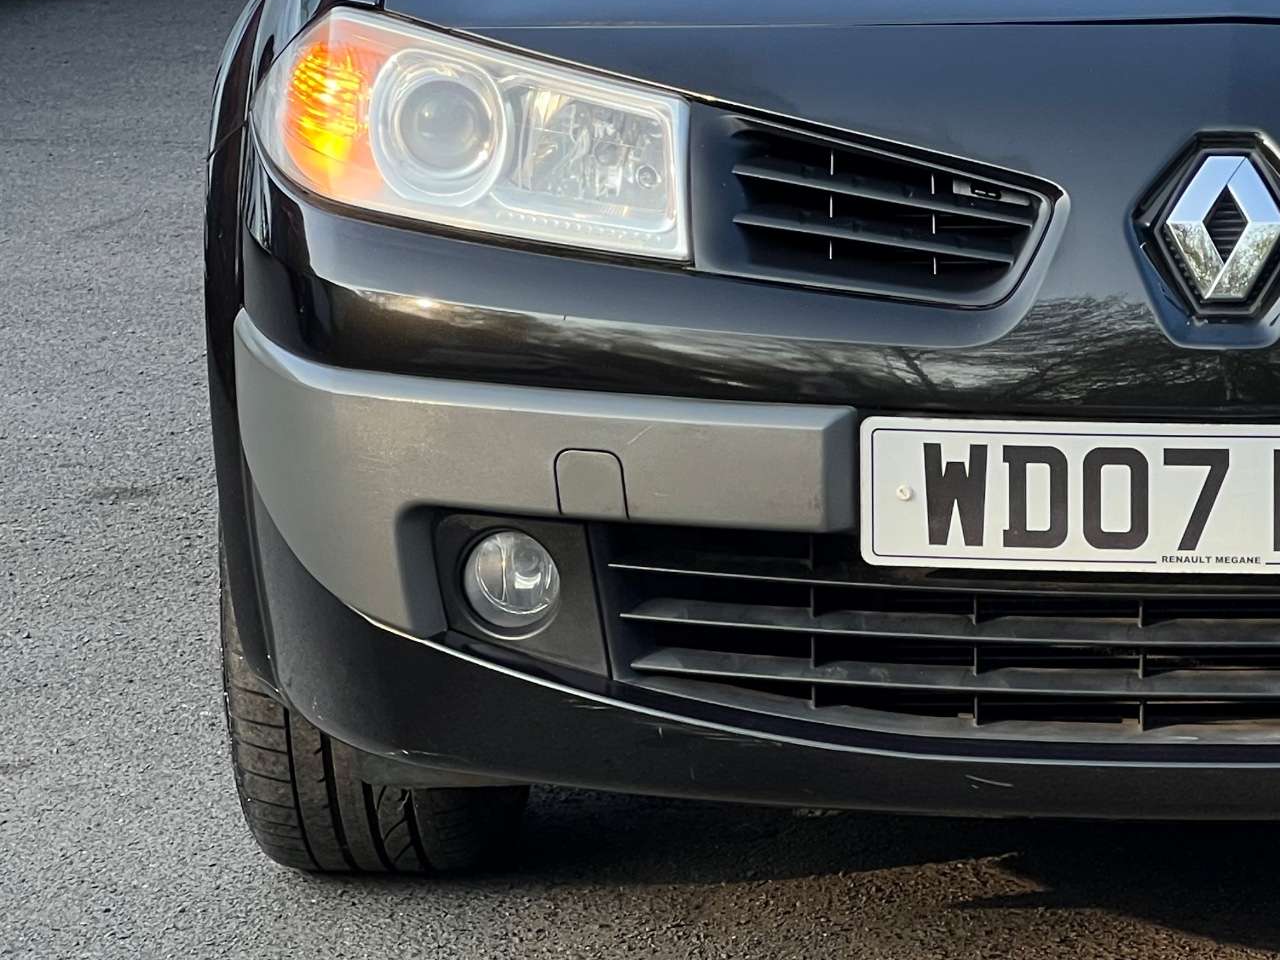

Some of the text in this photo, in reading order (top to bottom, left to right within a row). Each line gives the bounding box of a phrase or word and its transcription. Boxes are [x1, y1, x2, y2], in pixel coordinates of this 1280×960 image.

[923, 442, 1230, 551] WD07
[1161, 555, 1261, 564] RENAULT MEGANE
